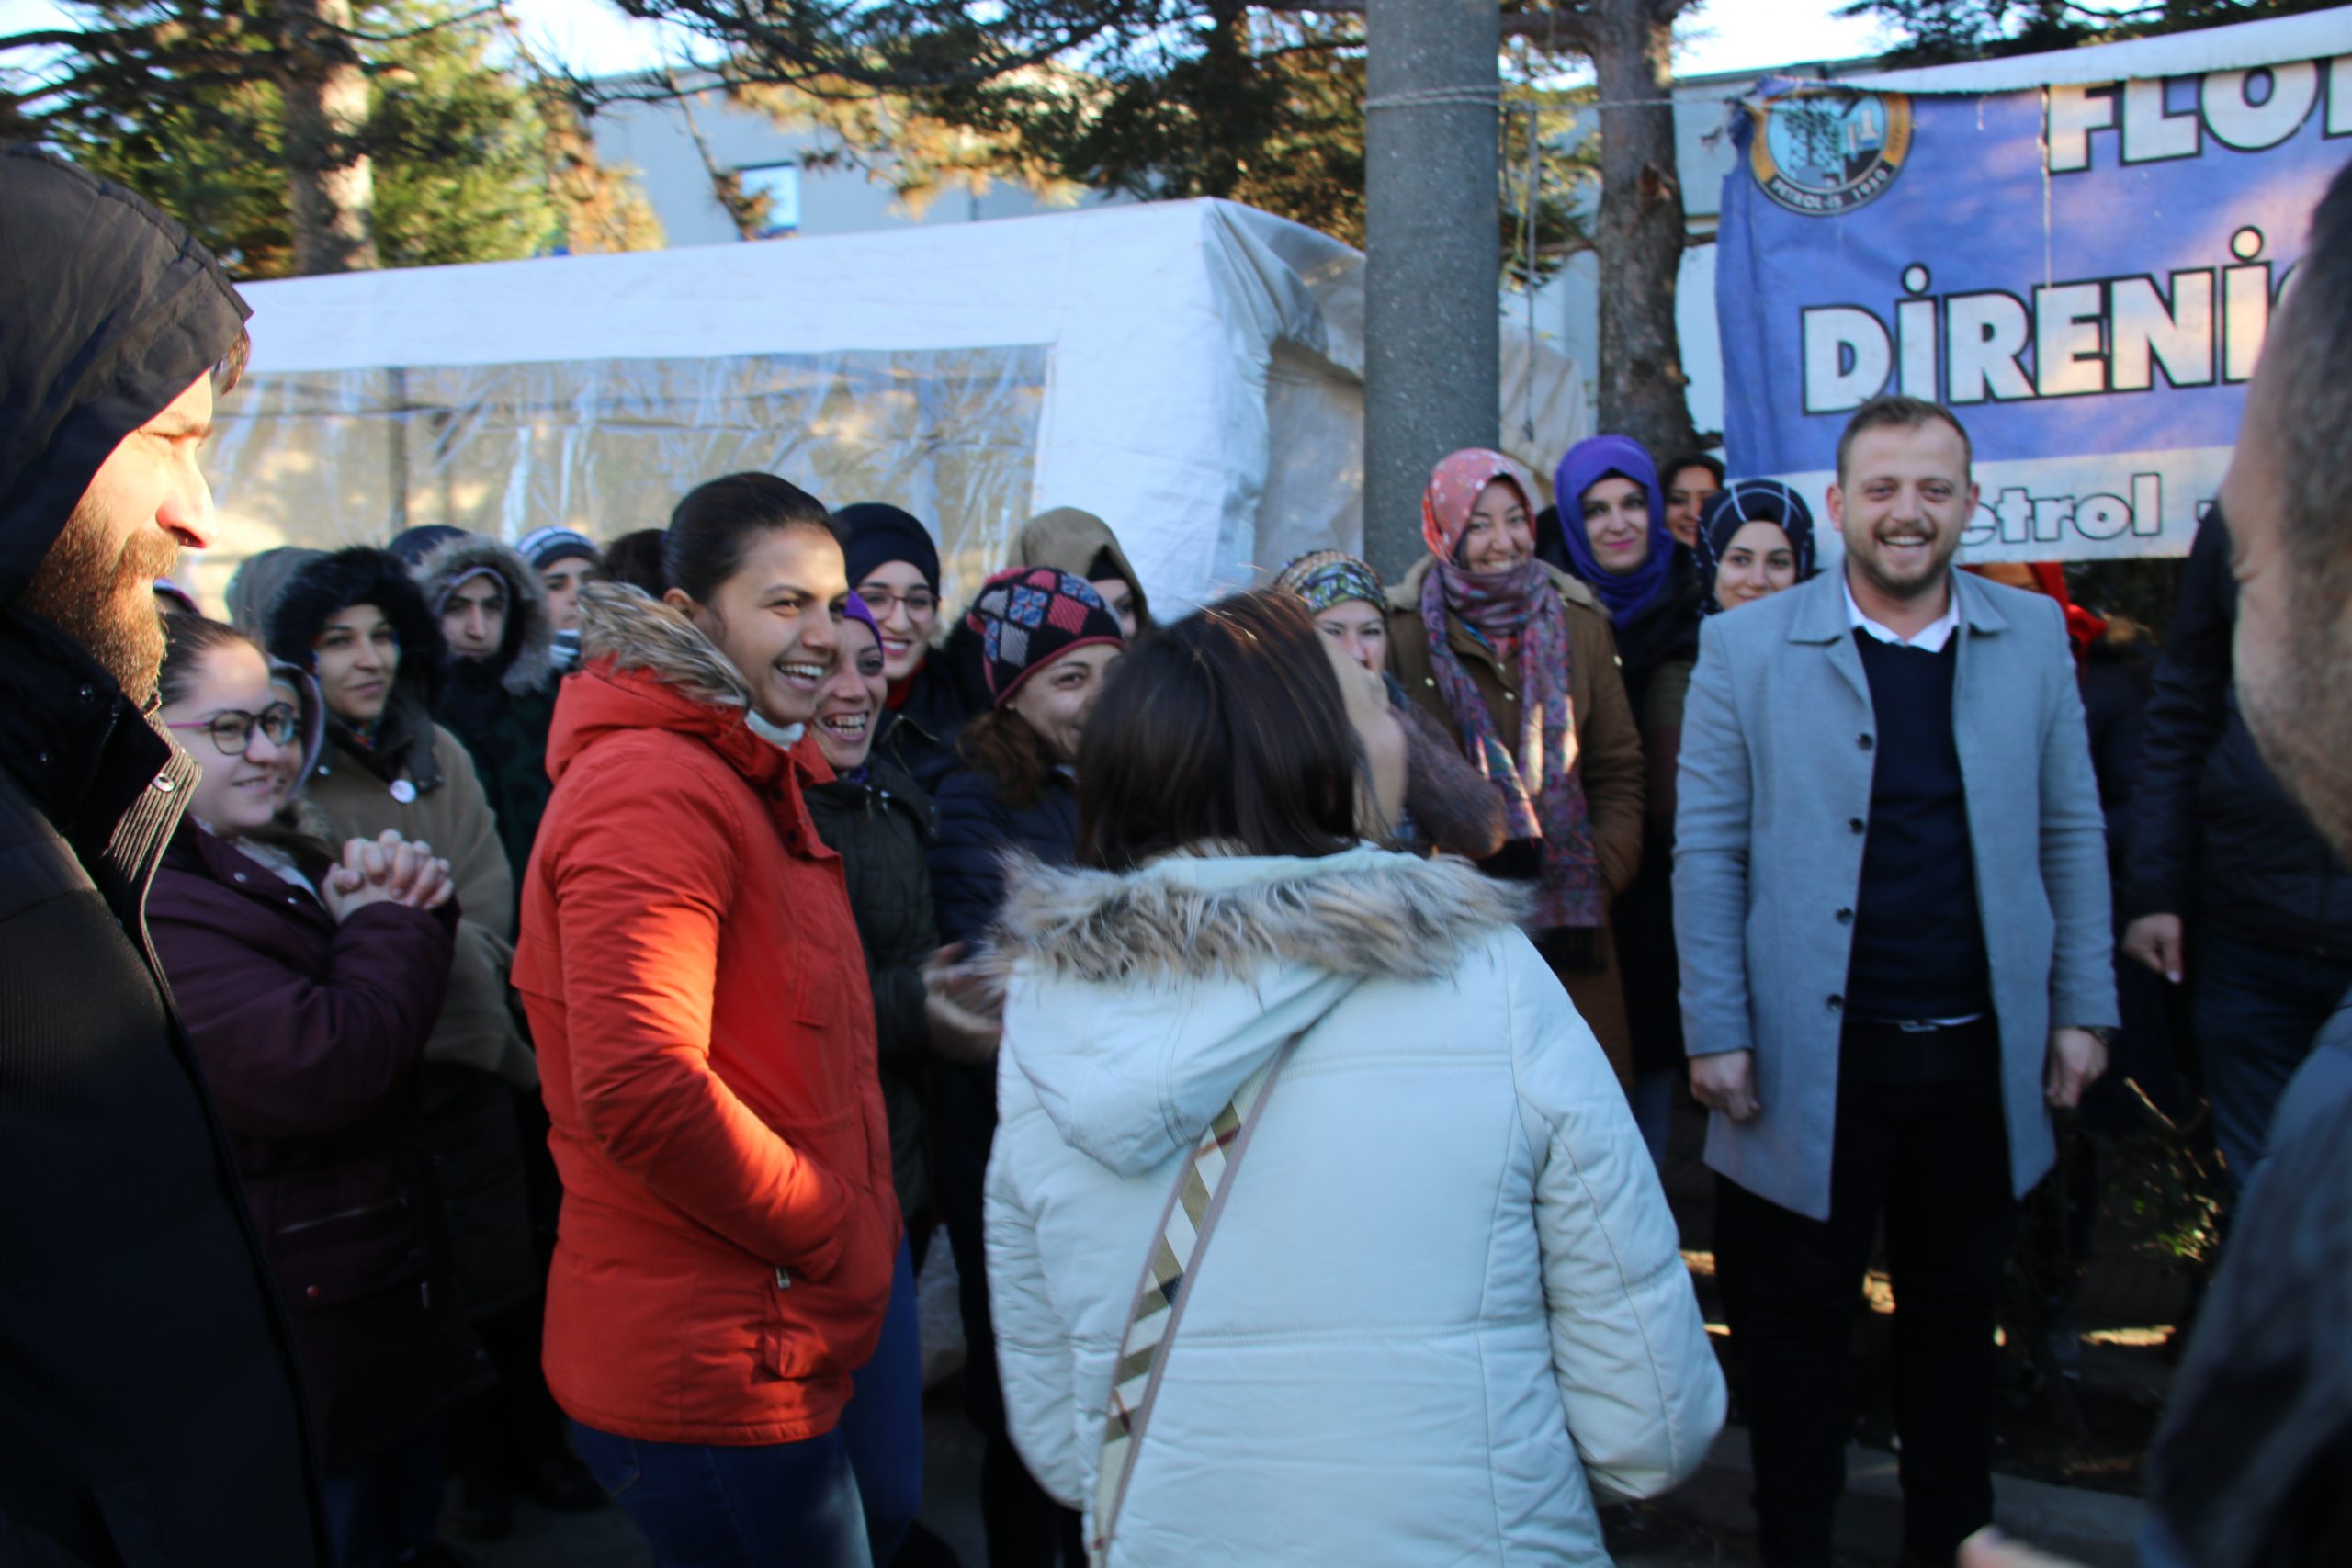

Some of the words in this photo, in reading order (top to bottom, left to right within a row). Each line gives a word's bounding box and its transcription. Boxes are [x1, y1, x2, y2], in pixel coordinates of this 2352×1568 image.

[2044, 56, 2352, 175] FLO
[1801, 226, 2305, 417] DİRENİ
[1959, 472, 2161, 547] etrol
